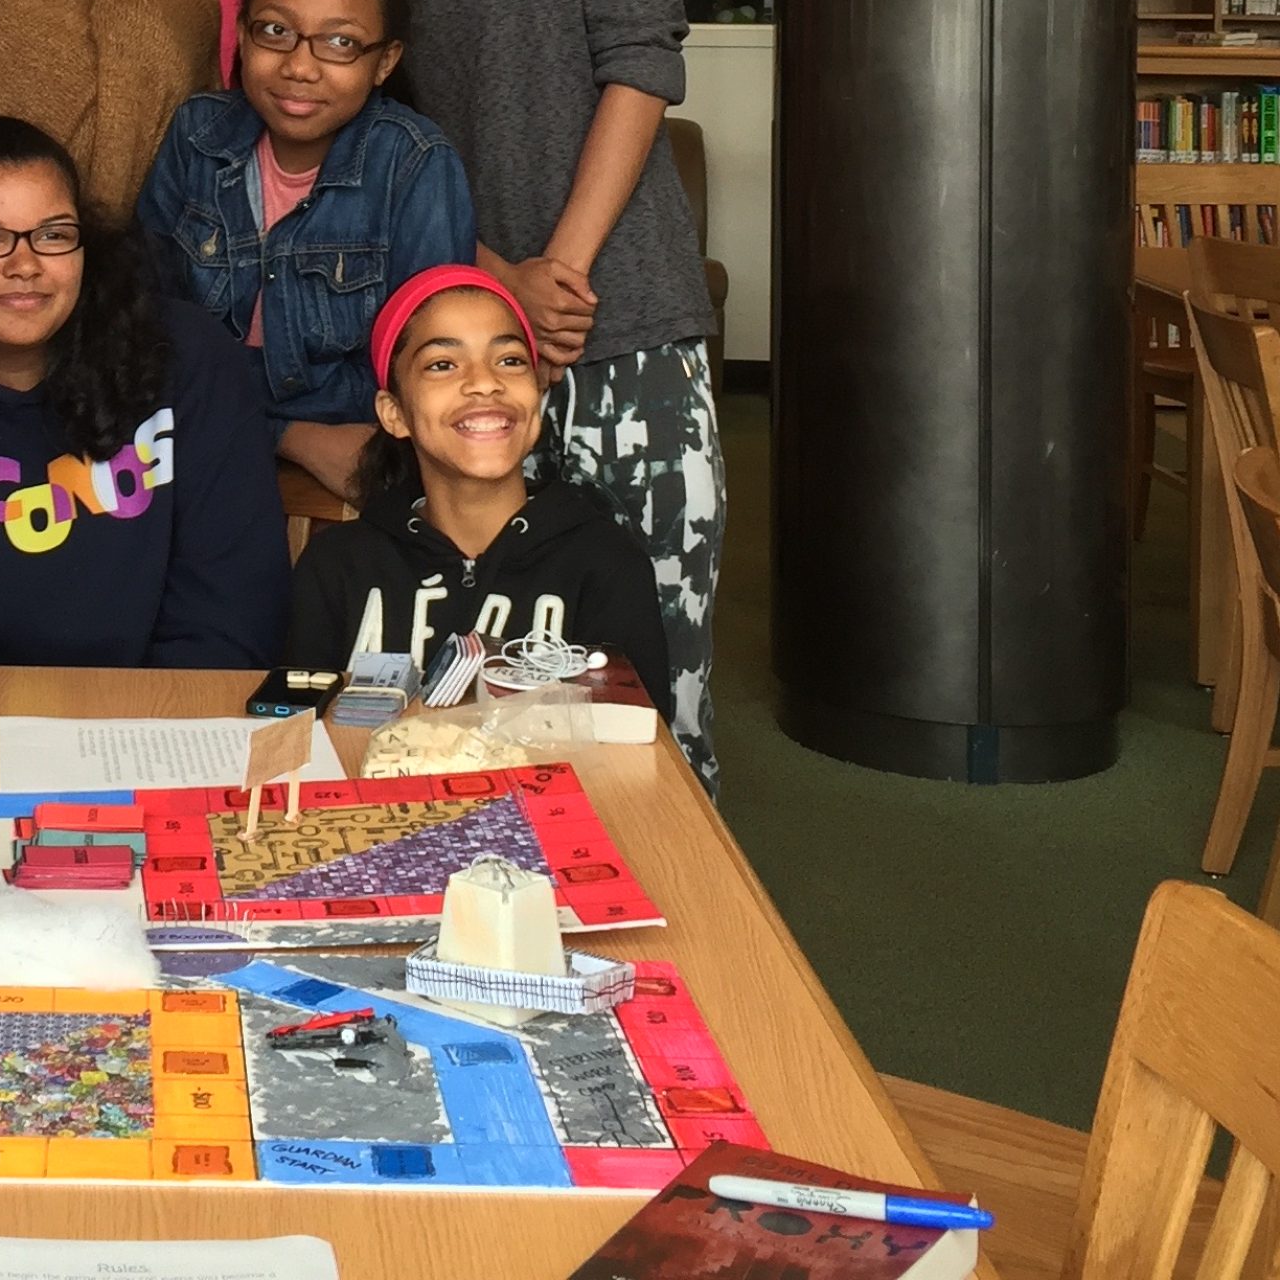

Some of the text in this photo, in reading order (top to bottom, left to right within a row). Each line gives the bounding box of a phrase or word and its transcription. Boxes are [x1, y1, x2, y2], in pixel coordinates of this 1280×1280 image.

[271, 1143, 362, 1170] GUARDIAN
[275, 1155, 336, 1175] START
[97, 1263, 148, 1273] Rules
